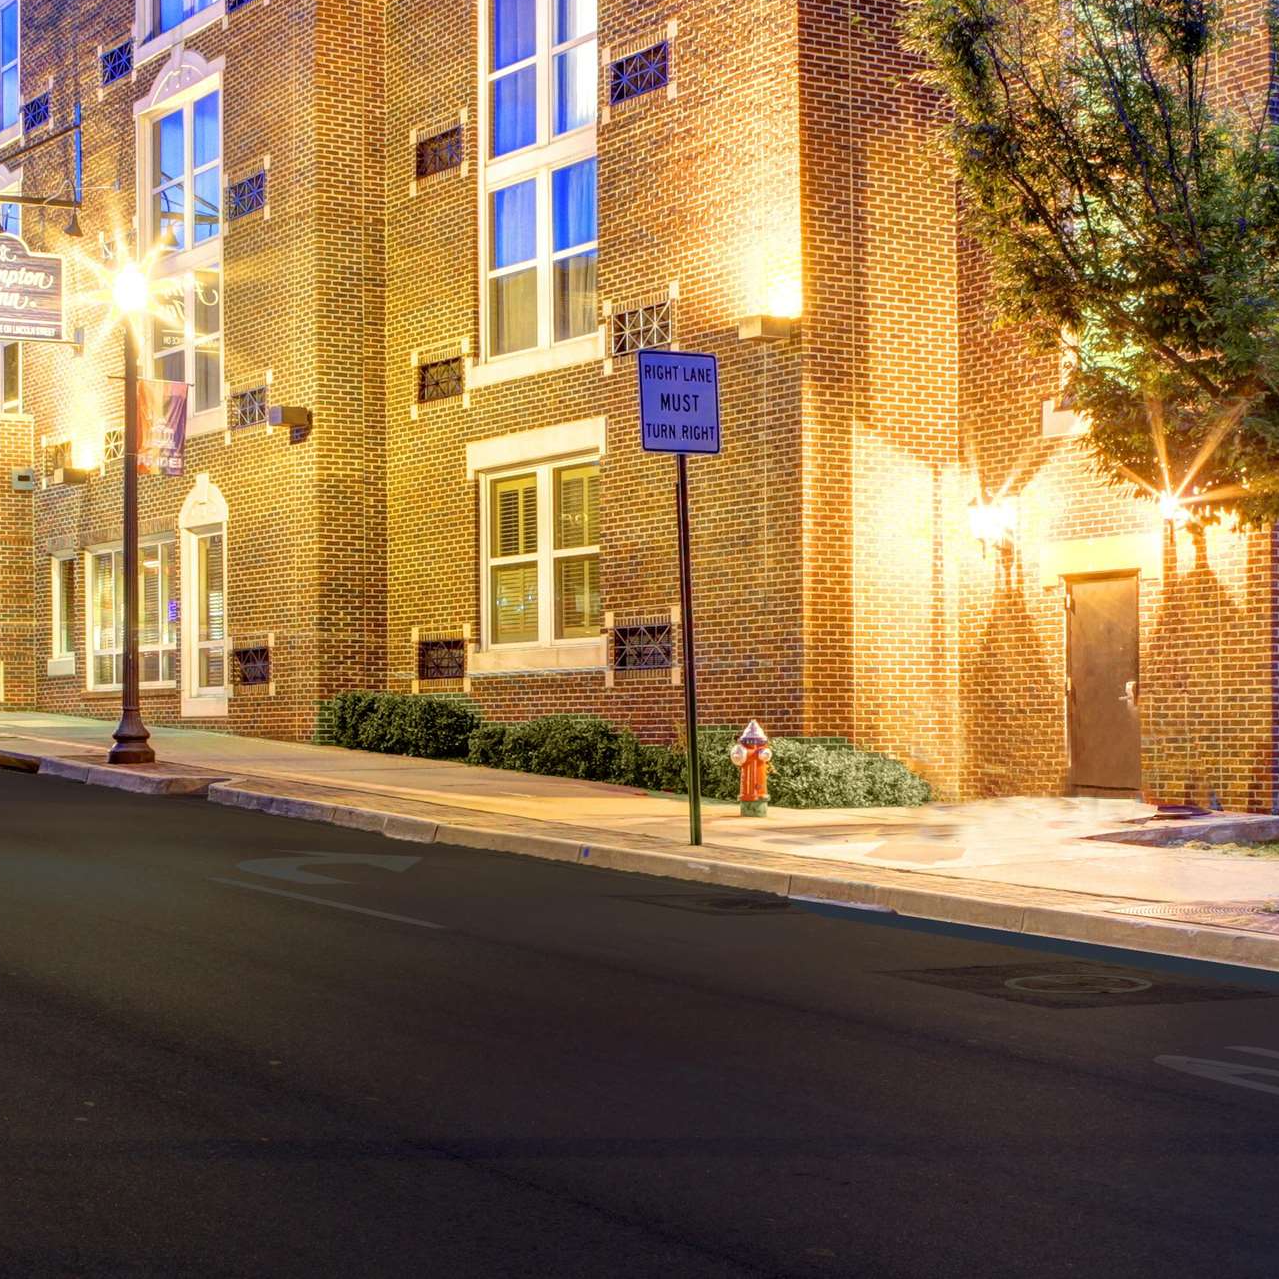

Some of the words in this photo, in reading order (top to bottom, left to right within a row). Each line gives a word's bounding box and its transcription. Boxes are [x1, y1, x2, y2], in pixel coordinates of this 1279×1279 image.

[645, 364, 680, 381] RIGHT
[683, 368, 712, 383] LANE
[660, 393, 700, 412] MUST
[646, 423, 676, 439] TURN
[682, 425, 715, 441] RIGHT
